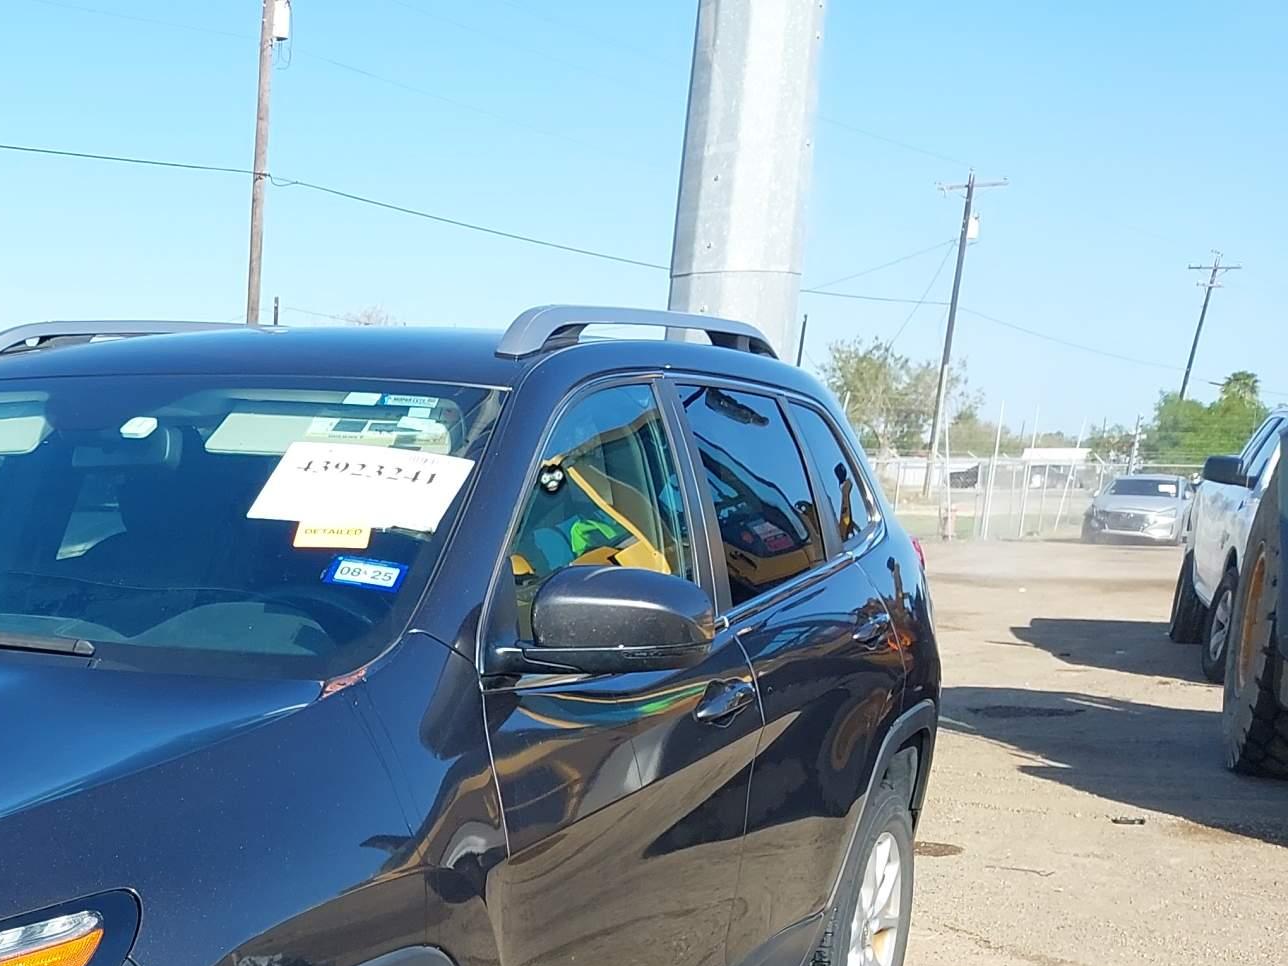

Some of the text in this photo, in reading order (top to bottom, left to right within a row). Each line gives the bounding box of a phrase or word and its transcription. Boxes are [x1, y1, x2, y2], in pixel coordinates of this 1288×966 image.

[297, 460, 437, 485] 43923241
[304, 528, 363, 536] DETAILED
[339, 566, 393, 582] 08 25
